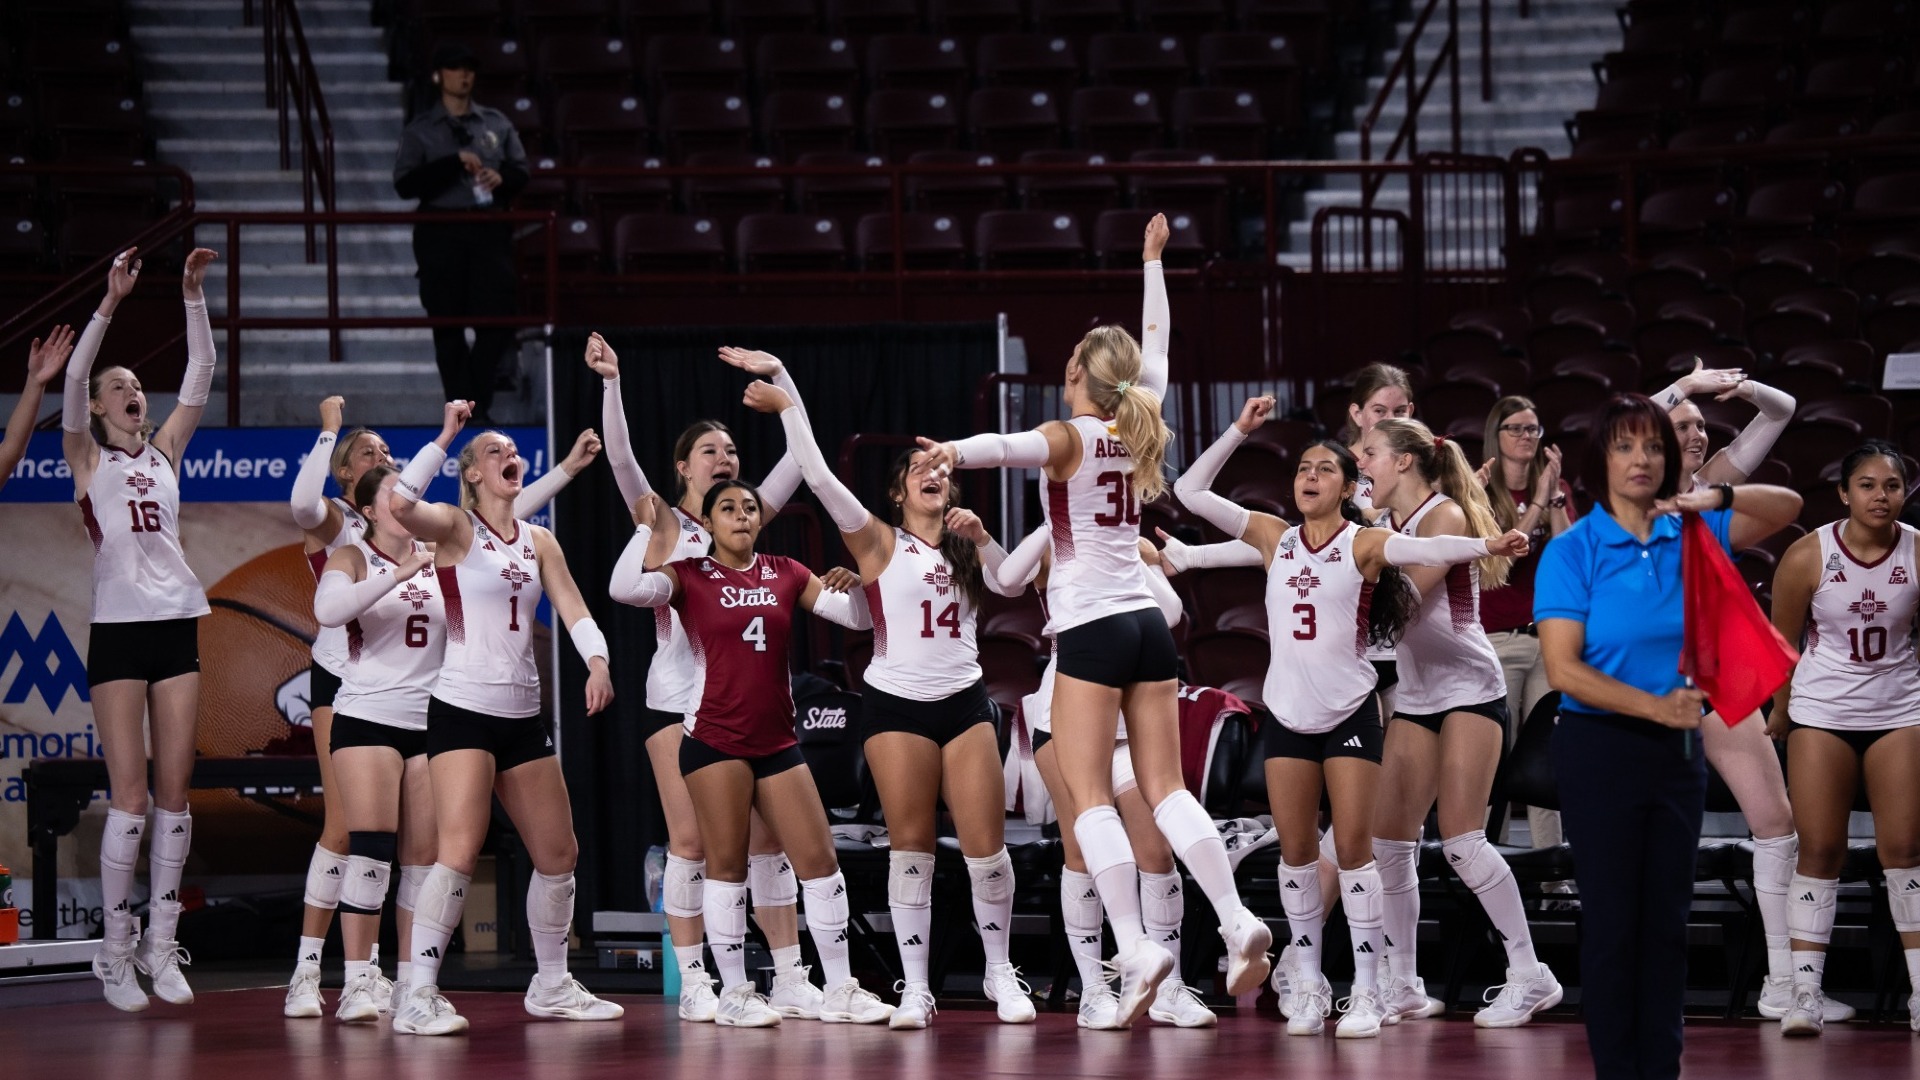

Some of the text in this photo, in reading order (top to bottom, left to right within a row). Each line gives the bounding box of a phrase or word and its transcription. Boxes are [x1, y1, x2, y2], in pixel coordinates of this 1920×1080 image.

[184, 449, 287, 478] where
[128, 500, 161, 532] 16
[761, 572, 778, 580] USA
[1888, 576, 1908, 585] USA
[509, 596, 519, 631] 1
[720, 586, 778, 609] State
[405, 614, 430, 648] 6
[741, 616, 767, 651] 4
[921, 600, 961, 638] 14
[1293, 604, 1316, 640] 3
[1847, 627, 1887, 662] 10
[803, 706, 846, 730] State
